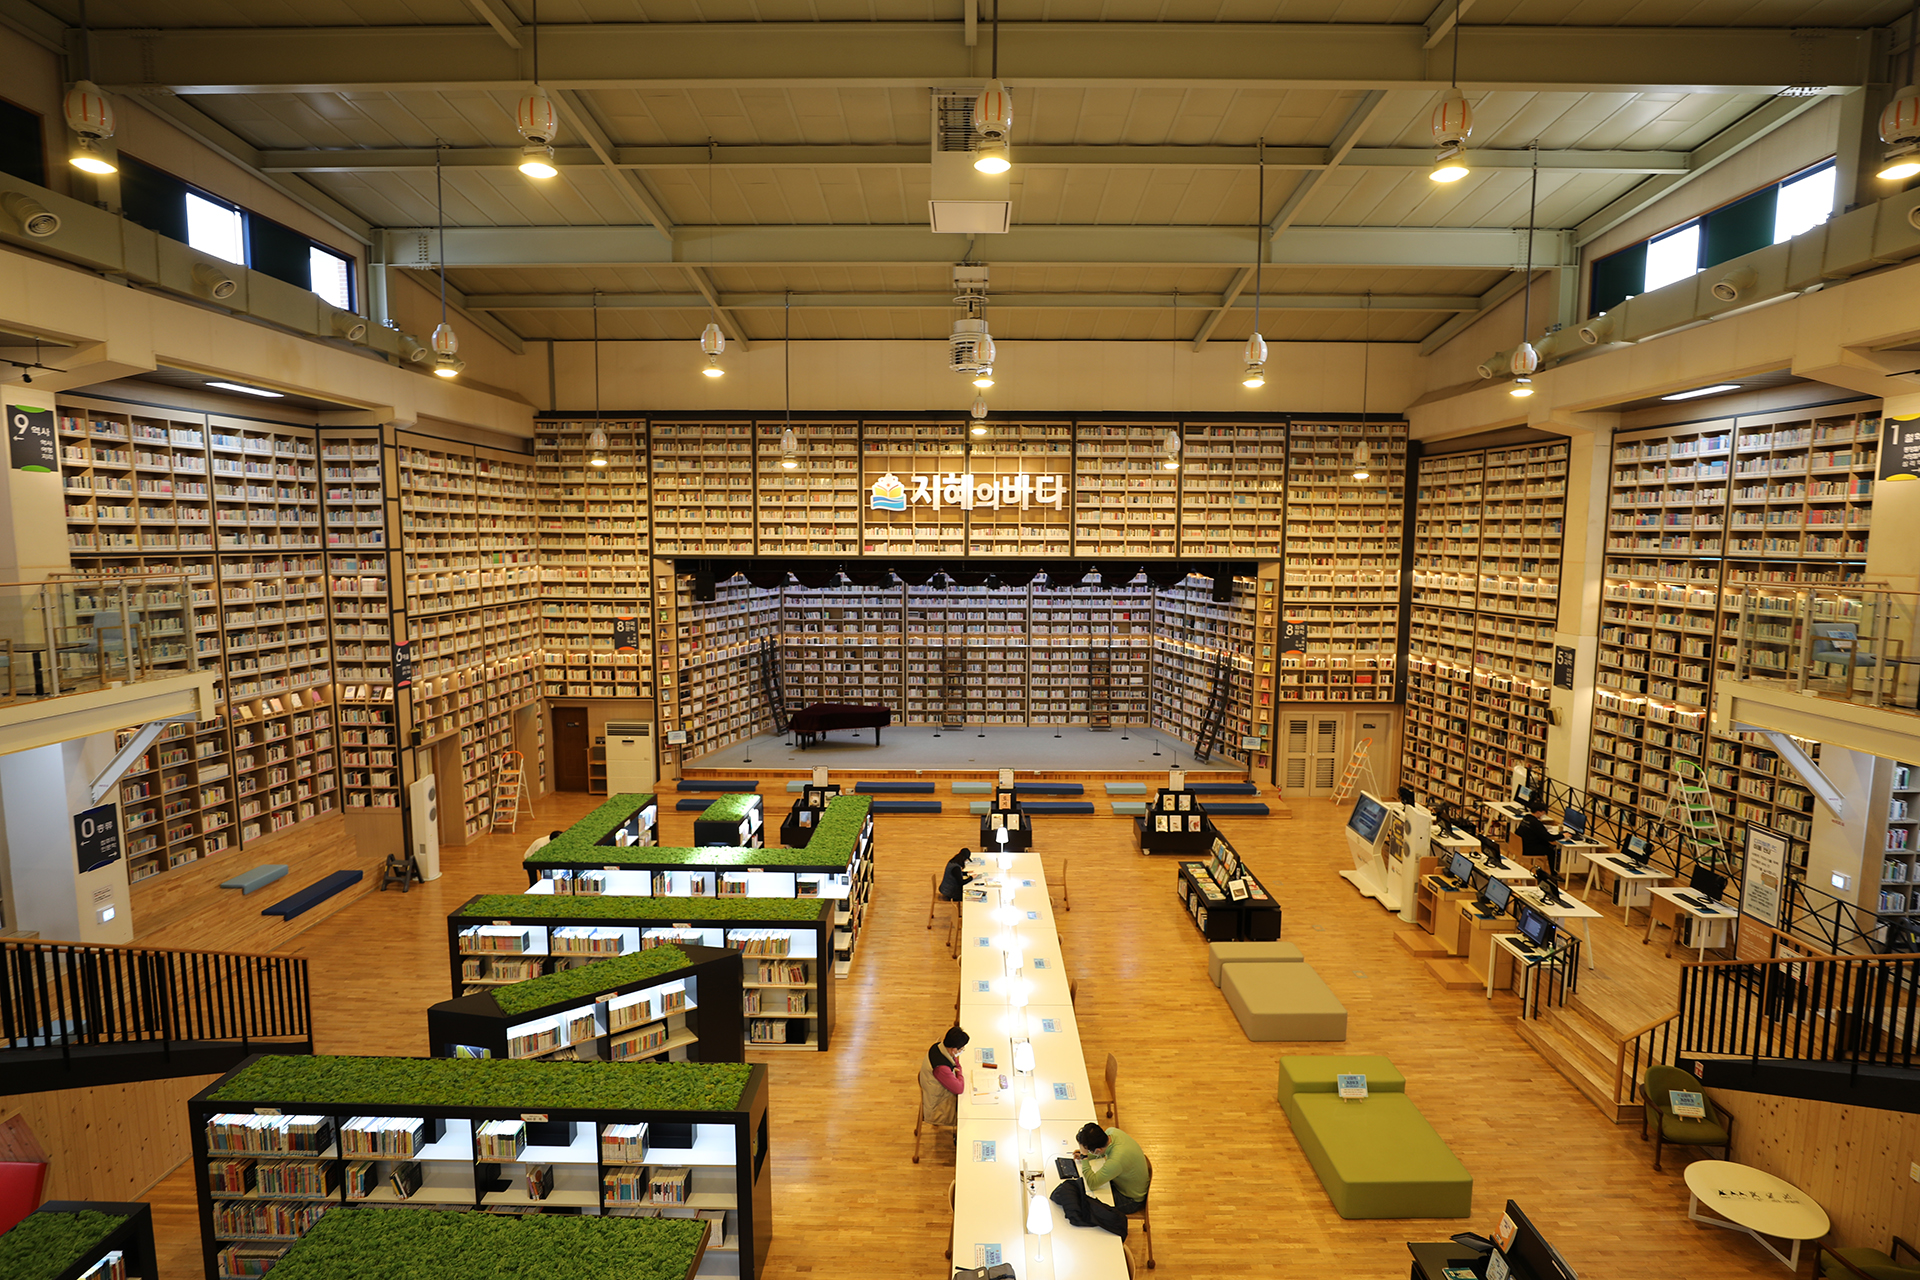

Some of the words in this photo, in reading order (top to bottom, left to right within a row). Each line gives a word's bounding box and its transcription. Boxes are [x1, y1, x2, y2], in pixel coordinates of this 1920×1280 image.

[13, 413, 29, 435] 9
[30, 425, 51, 437] 역사
[1891, 424, 1900, 445] 1
[910, 472, 1067, 511] 지혜의바다
[616, 620, 625, 632] 8
[1286, 624, 1294, 636] 8
[395, 647, 403, 663] 6
[1557, 651, 1564, 665] 5
[81, 818, 95, 839] 0
[96, 820, 114, 834] 총류
